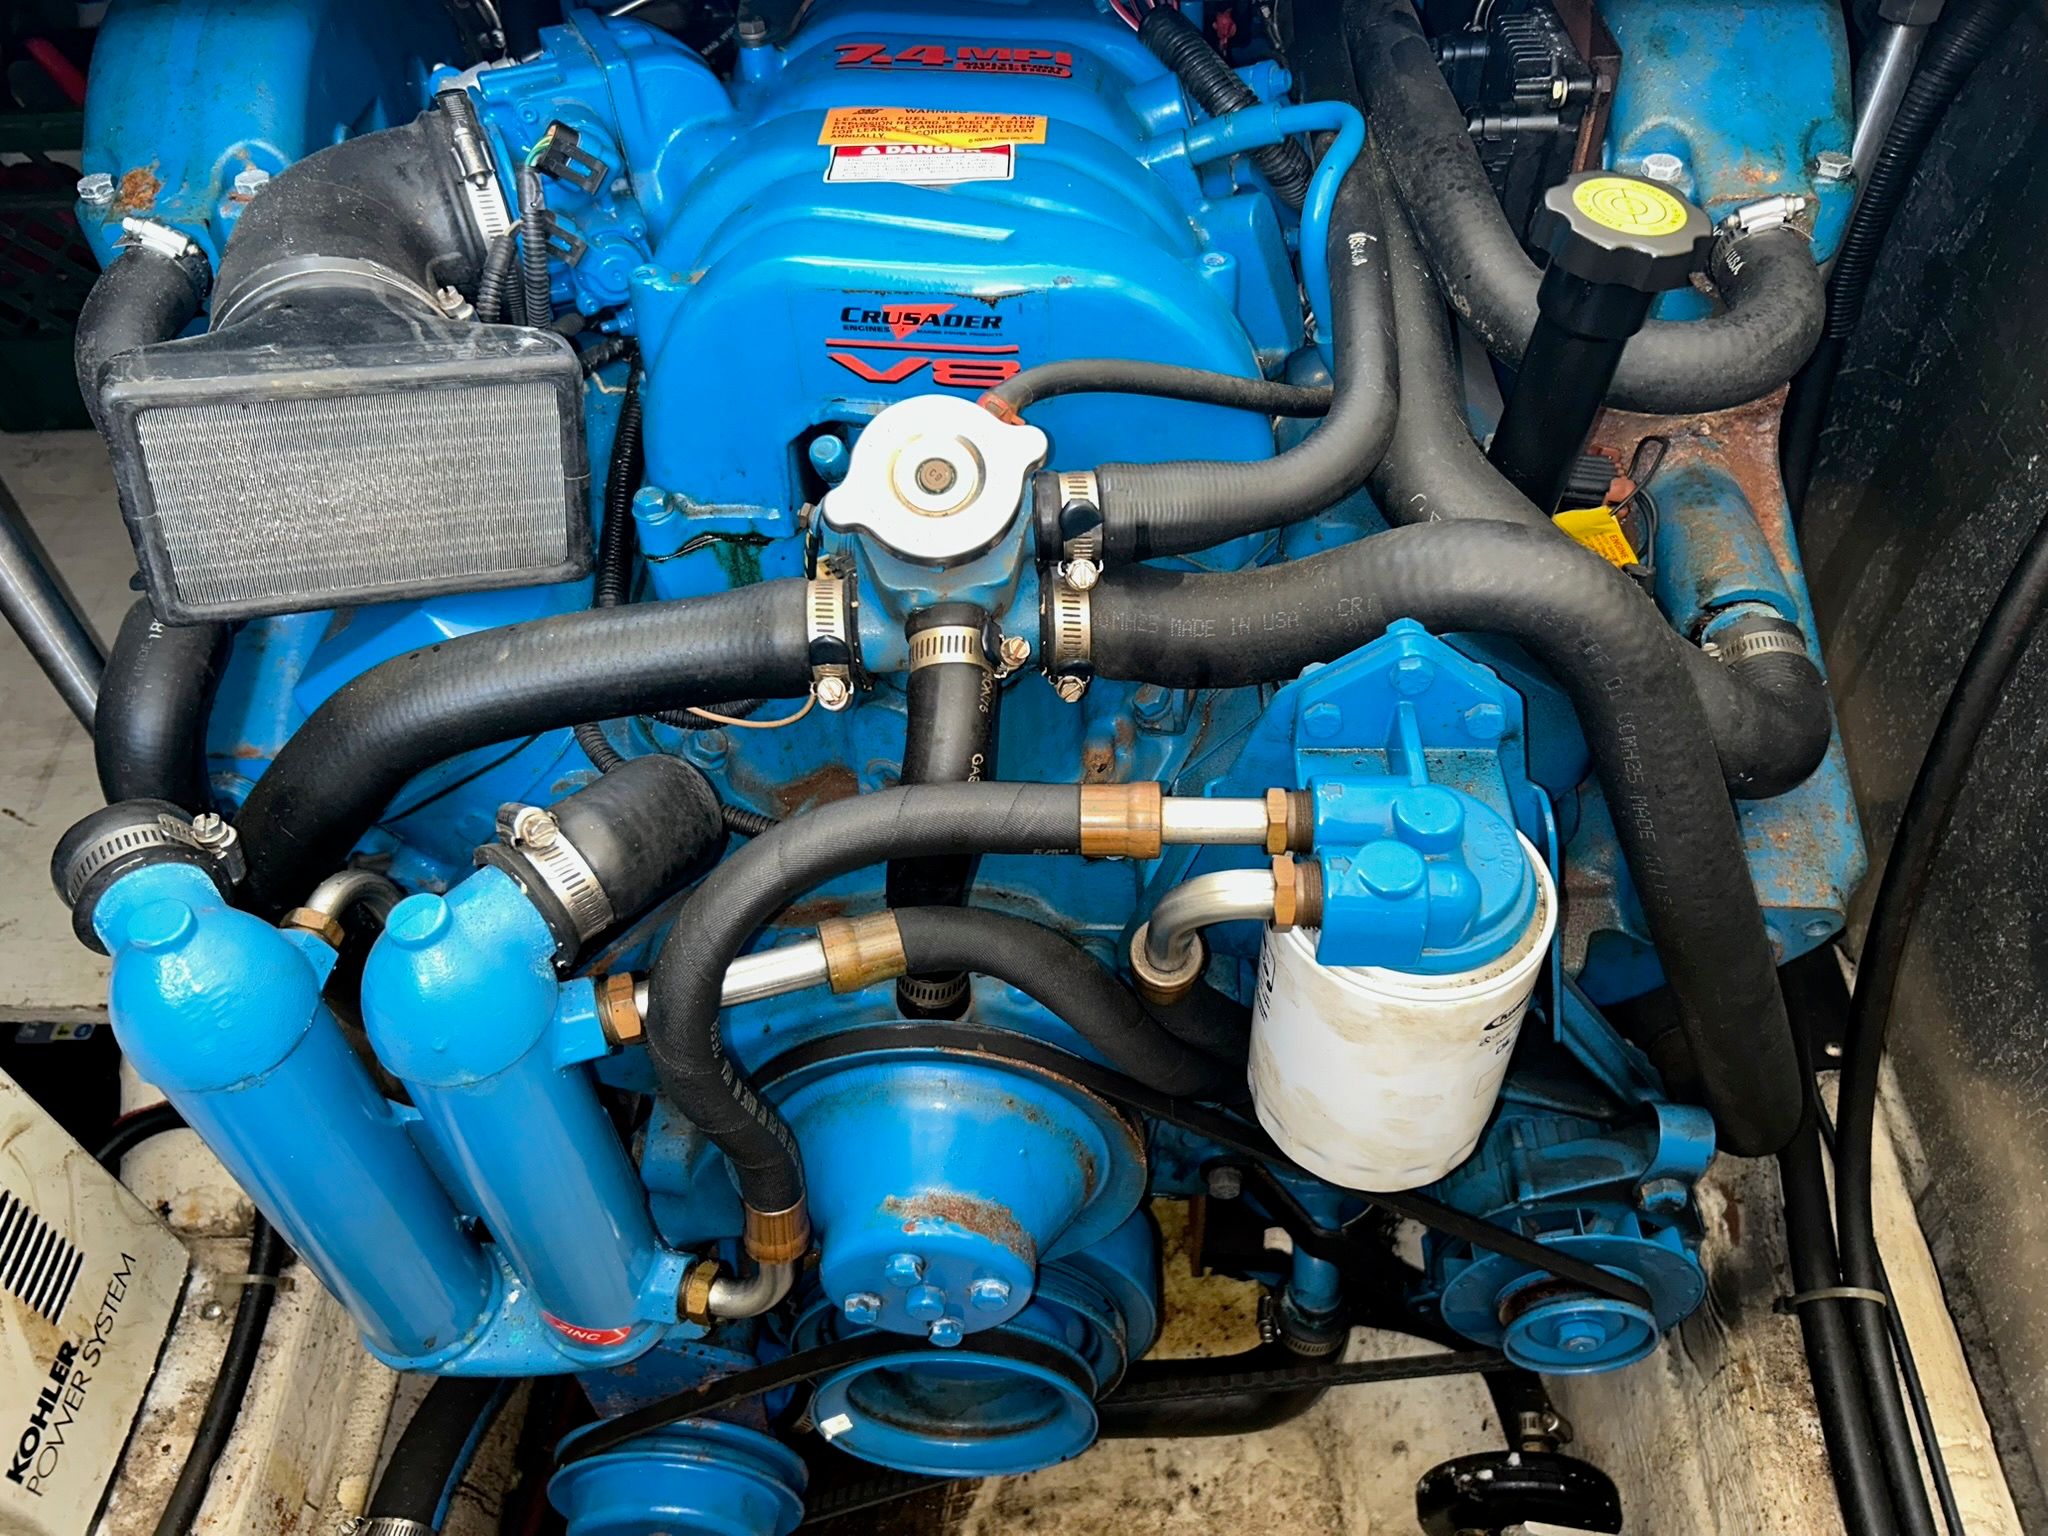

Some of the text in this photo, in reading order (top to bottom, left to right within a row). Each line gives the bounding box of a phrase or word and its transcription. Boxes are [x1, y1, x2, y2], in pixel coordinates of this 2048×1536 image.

[834, 43, 1073, 67] 7.4 MPI
[915, 128, 979, 136] CORROSION
[842, 324, 891, 333] ENGINES
[827, 352, 1021, 389] V8
[1609, 534, 1629, 559] ENGINE
[1170, 616, 1217, 639] MADE
[1230, 616, 1250, 636] IN
[1262, 609, 1300, 632] USA
[26, 1252, 136, 1497] POWER SYSTEM
[5, 1340, 80, 1485] KOHLER
